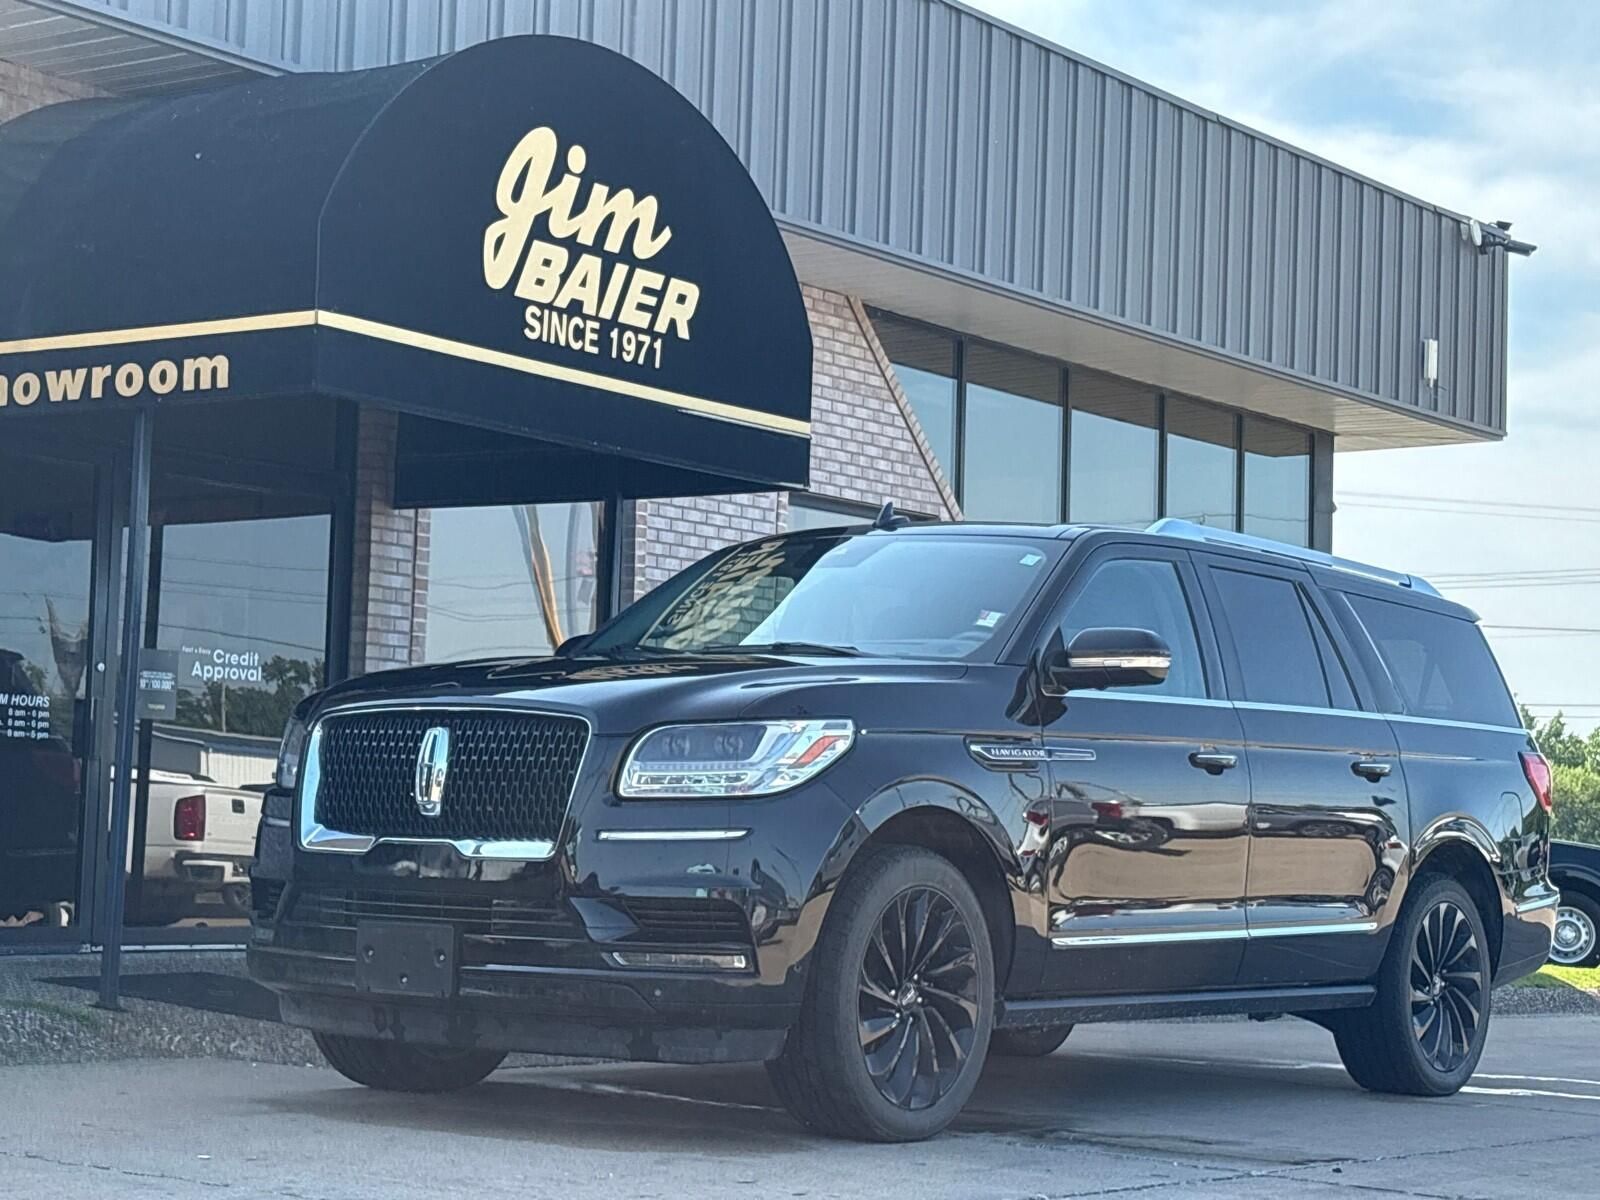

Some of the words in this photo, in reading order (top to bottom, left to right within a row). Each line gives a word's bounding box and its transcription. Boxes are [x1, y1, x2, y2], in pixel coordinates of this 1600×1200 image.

[484, 126, 672, 289] Jim
[514, 239, 700, 340] BAIER
[524, 305, 600, 354] SINCE
[610, 328, 662, 368] 1971
[213, 649, 259, 666] Credit
[191, 660, 262, 682] Approval
[11, 694, 50, 708] HOURS
[38, 710, 50, 719] pm
[37, 721, 49, 730] pm
[37, 732, 49, 740] pm
[990, 748, 1045, 758] NAVIGATOR
